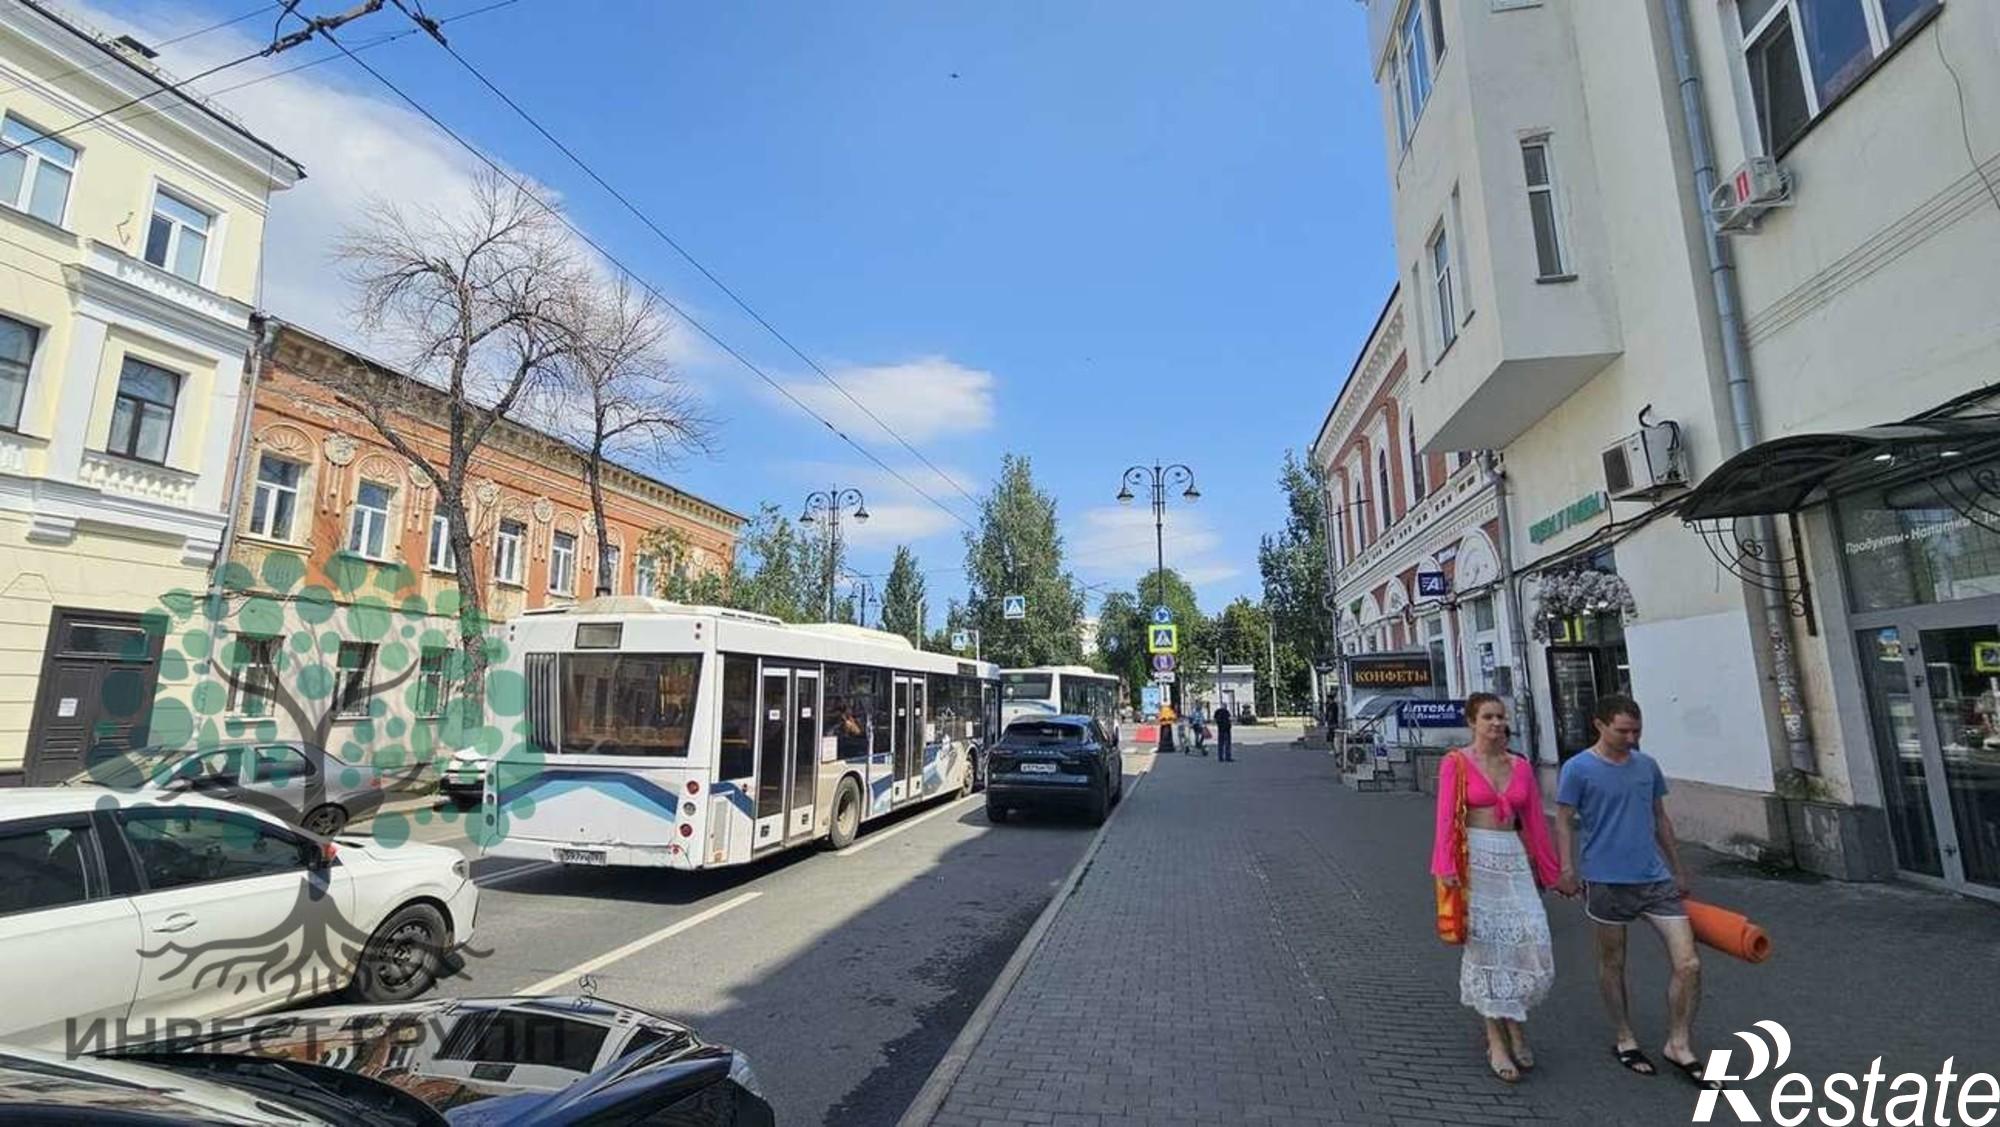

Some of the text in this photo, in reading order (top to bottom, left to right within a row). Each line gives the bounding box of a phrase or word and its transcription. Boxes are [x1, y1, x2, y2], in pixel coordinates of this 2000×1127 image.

[1845, 532, 1904, 555] Продукты
[1911, 519, 1971, 541] Напитки
[1354, 670, 1429, 683] КОНФЕТЫ
